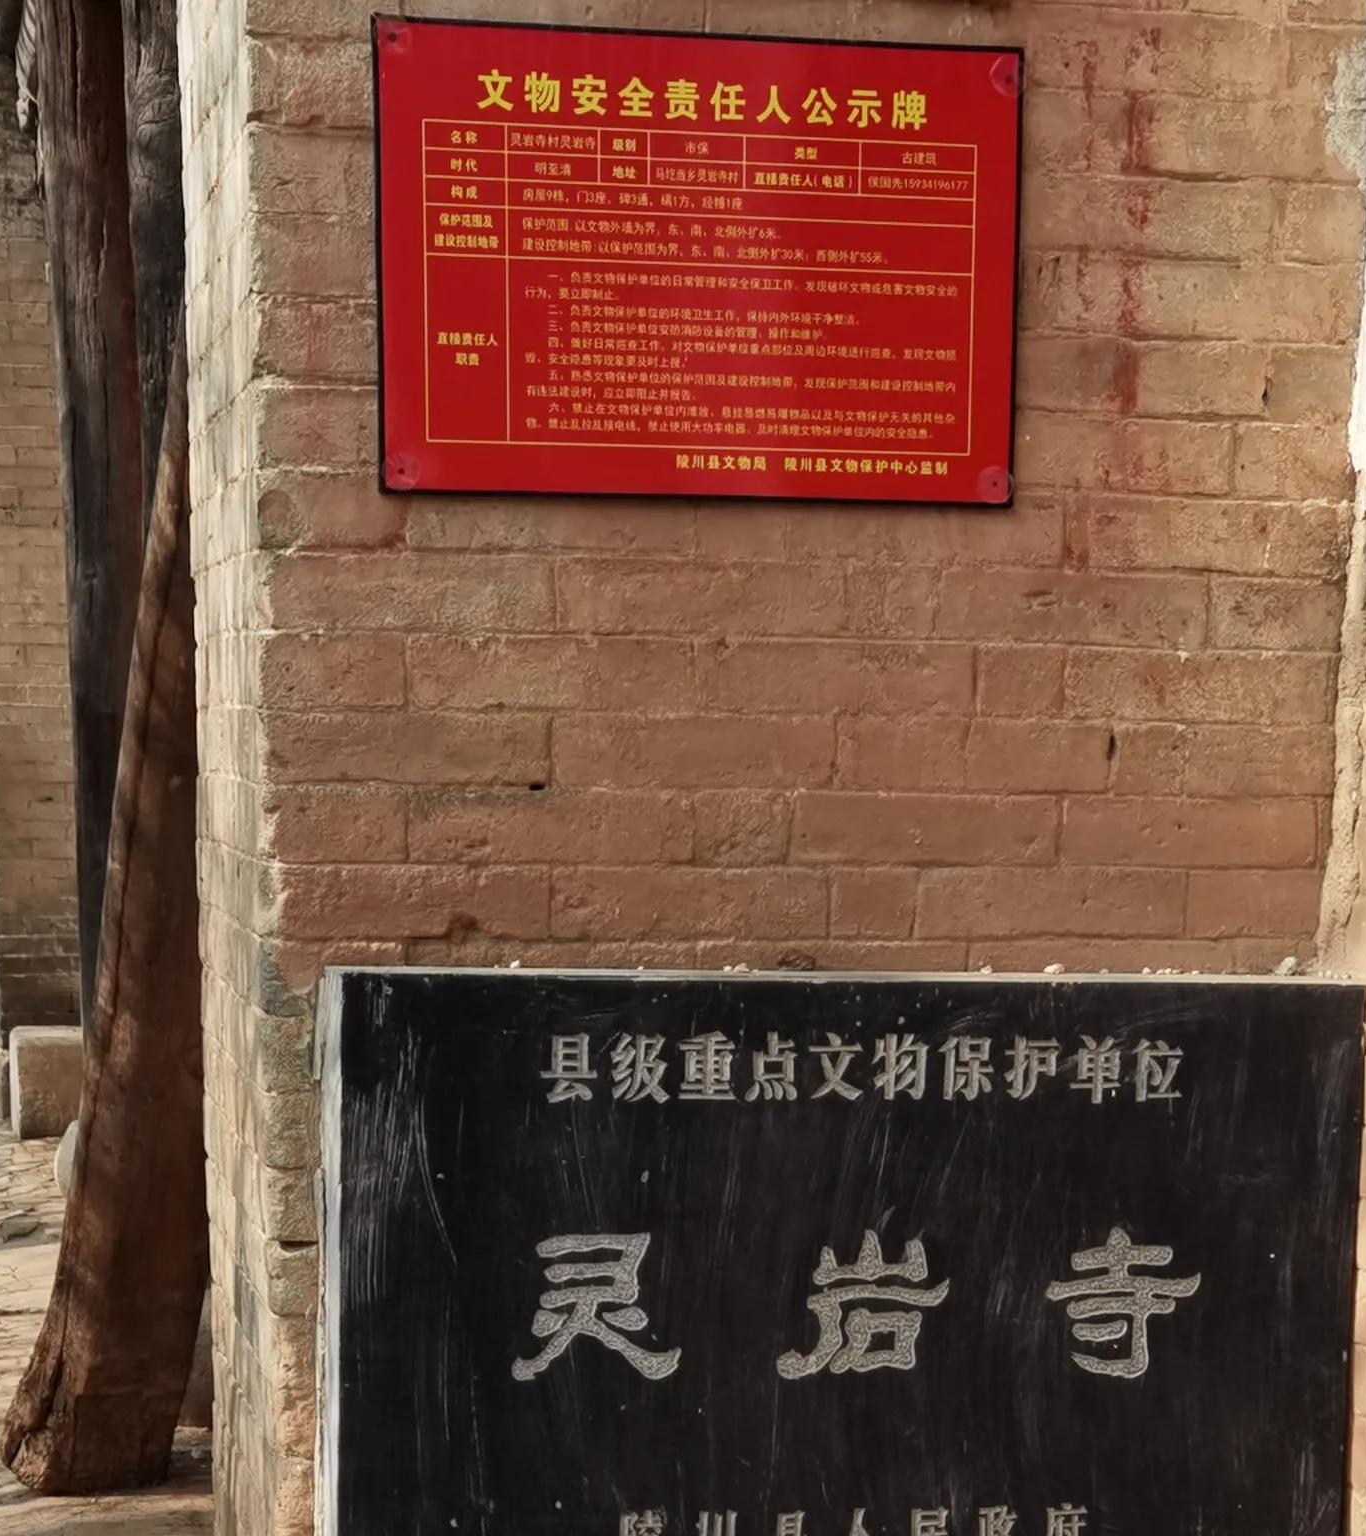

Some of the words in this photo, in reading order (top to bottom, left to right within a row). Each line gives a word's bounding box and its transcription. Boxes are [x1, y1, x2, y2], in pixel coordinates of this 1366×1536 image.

[477, 69, 928, 130] 文物安全责任人公示牌
[450, 130, 478, 145] 名称
[510, 132, 596, 150] 灵岩寺村灵岩寺
[612, 138, 637, 152] 级别
[795, 146, 818, 160] 类型
[902, 151, 937, 166] 古建筑
[450, 158, 478, 172] 时代
[534, 161, 572, 176] 明至清
[612, 165, 636, 180] 地址
[451, 184, 478, 199] 构成
[439, 213, 493, 229] 保护范围及
[435, 233, 499, 249] 建设控制地带
[437, 332, 498, 346] 直接责任人
[455, 352, 479, 366] 职责
[676, 454, 767, 471] 陵川县文物局
[784, 455, 949, 476] 陵川县文物保护中心监制
[539, 1030, 1185, 1107] 县级重点文物保护单位
[510, 1226, 1202, 1381] 灵岩寺
